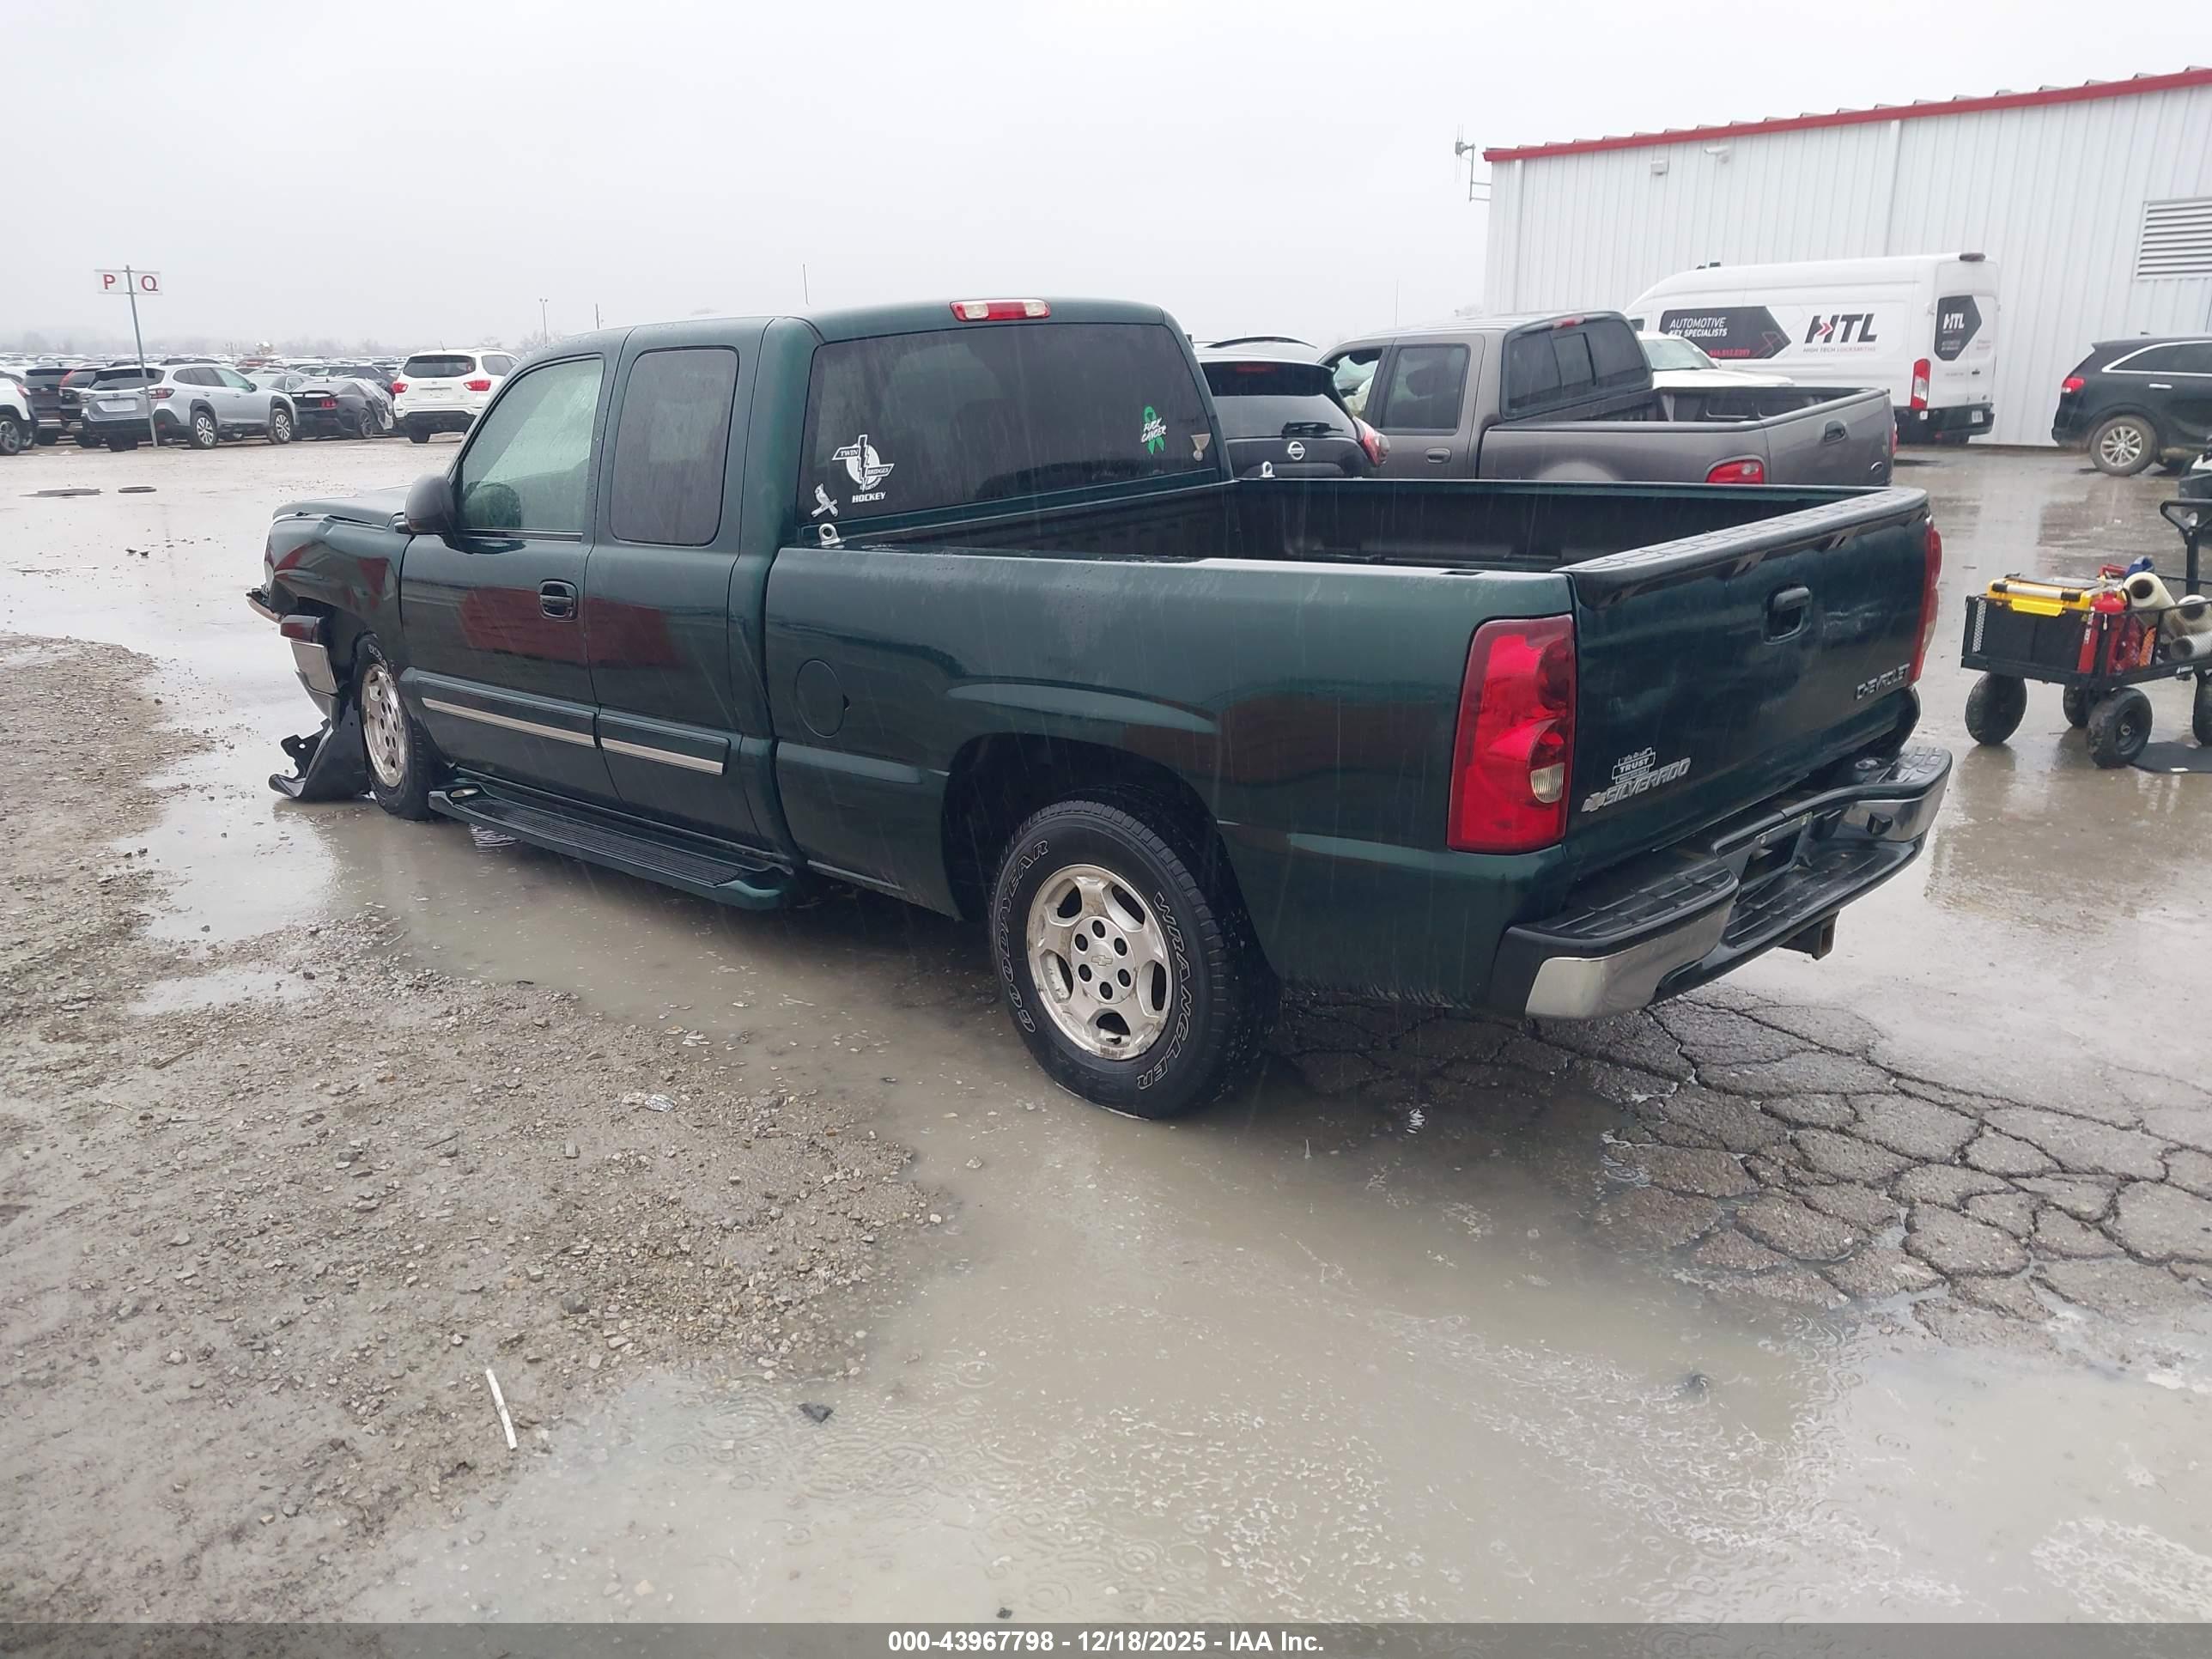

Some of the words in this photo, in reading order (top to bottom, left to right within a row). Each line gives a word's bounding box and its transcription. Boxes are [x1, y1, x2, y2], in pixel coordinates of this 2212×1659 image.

[102, 273, 116, 290] P
[141, 275, 159, 291] Q
[1669, 317, 1727, 329] AUTOMOTIVE
[1804, 313, 1878, 343] HTL
[1942, 313, 1965, 330] HTL
[1684, 328, 1729, 337] SPECIALISTS
[1141, 424, 1167, 443] CANCER
[852, 491, 886, 503] HOCKEY
[1856, 663, 1911, 700] CHEVROLET
[1620, 757, 1650, 774] TRUST
[1603, 757, 1692, 806] SILVERADO
[998, 839, 1050, 1034] GOODYEAR
[1136, 891, 1192, 1091] WRANGLER
